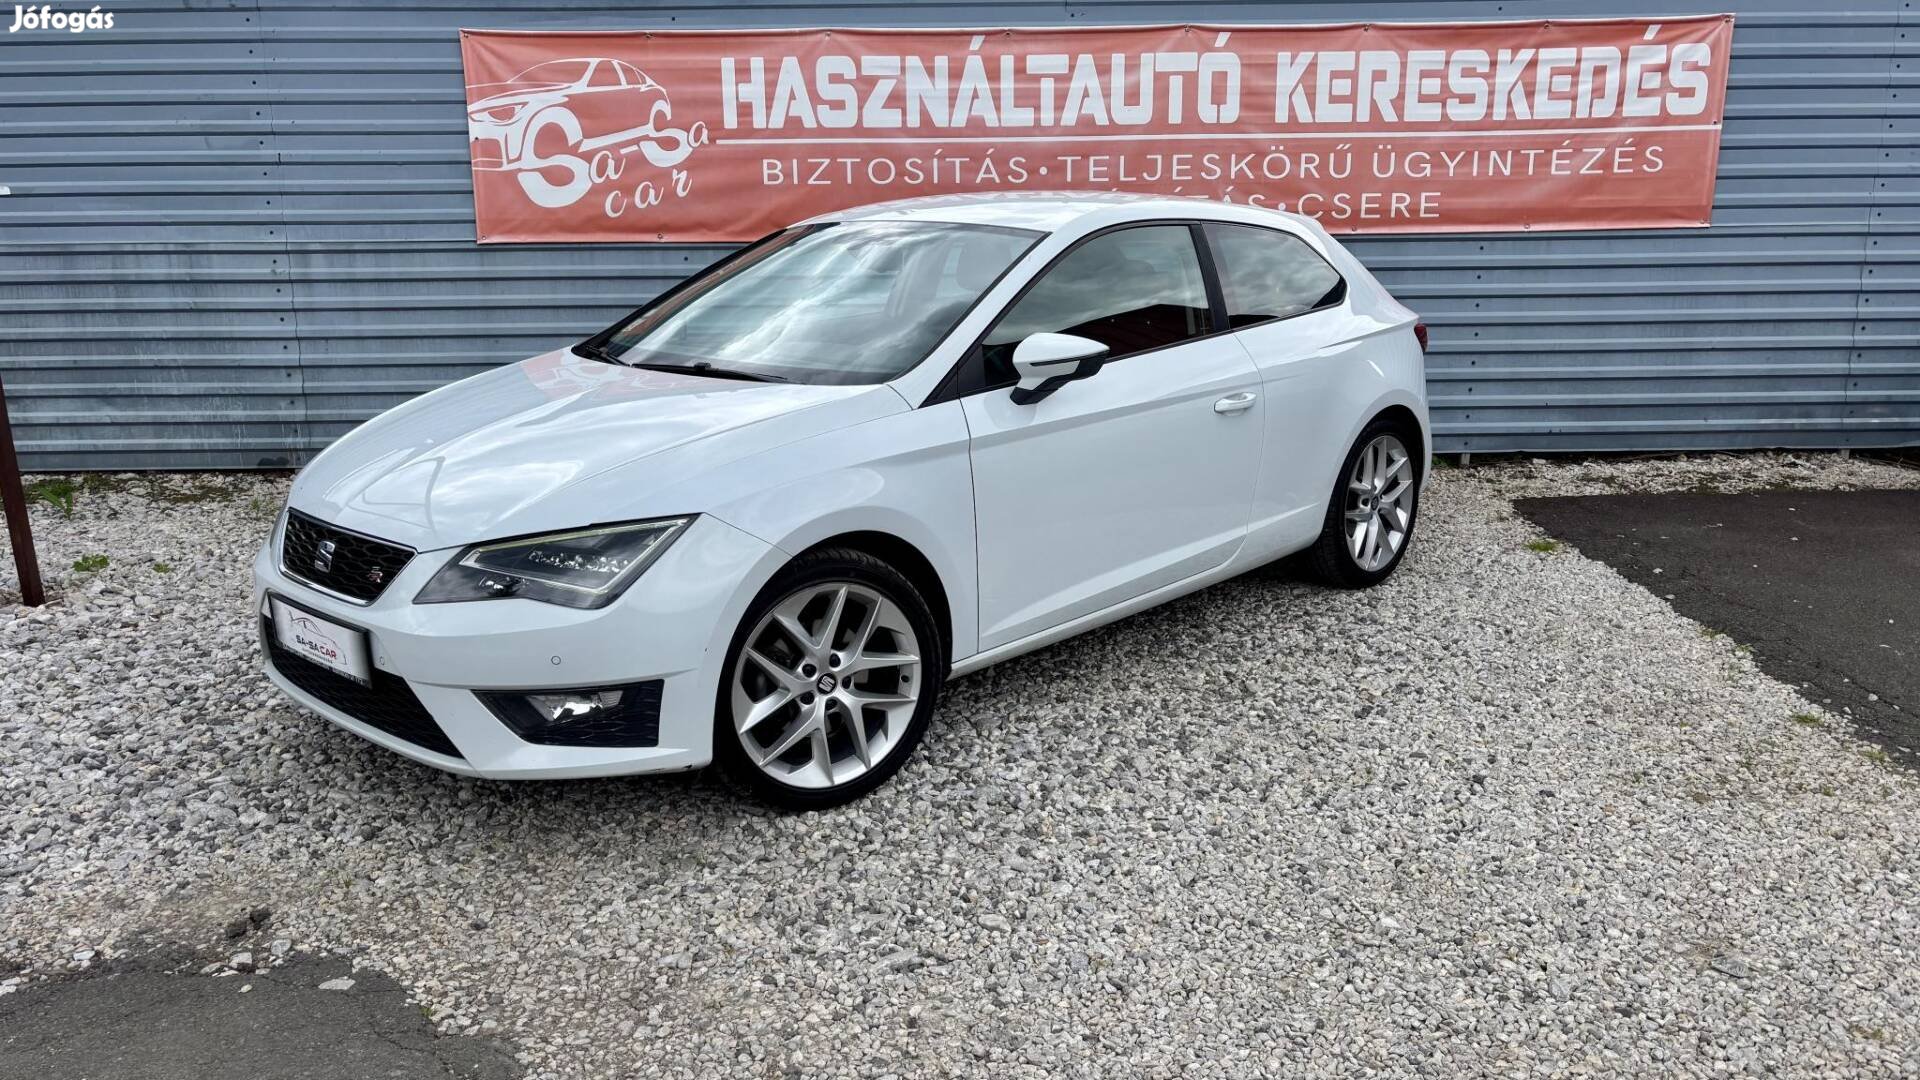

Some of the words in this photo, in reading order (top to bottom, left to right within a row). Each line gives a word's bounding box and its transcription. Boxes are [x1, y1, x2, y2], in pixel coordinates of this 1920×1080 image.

[720, 31, 1241, 129] HASZNÁLTAUTÓ
[1275, 25, 1711, 123] KERESKEDÉS
[762, 148, 1028, 185] BIZTOSÍTÁS
[1057, 143, 1352, 183] TELJESKÖRŰ
[1372, 139, 1665, 179] ÜGYINTÉZÉS
[604, 168, 693, 218] car
[1298, 191, 1441, 218] CSERE
